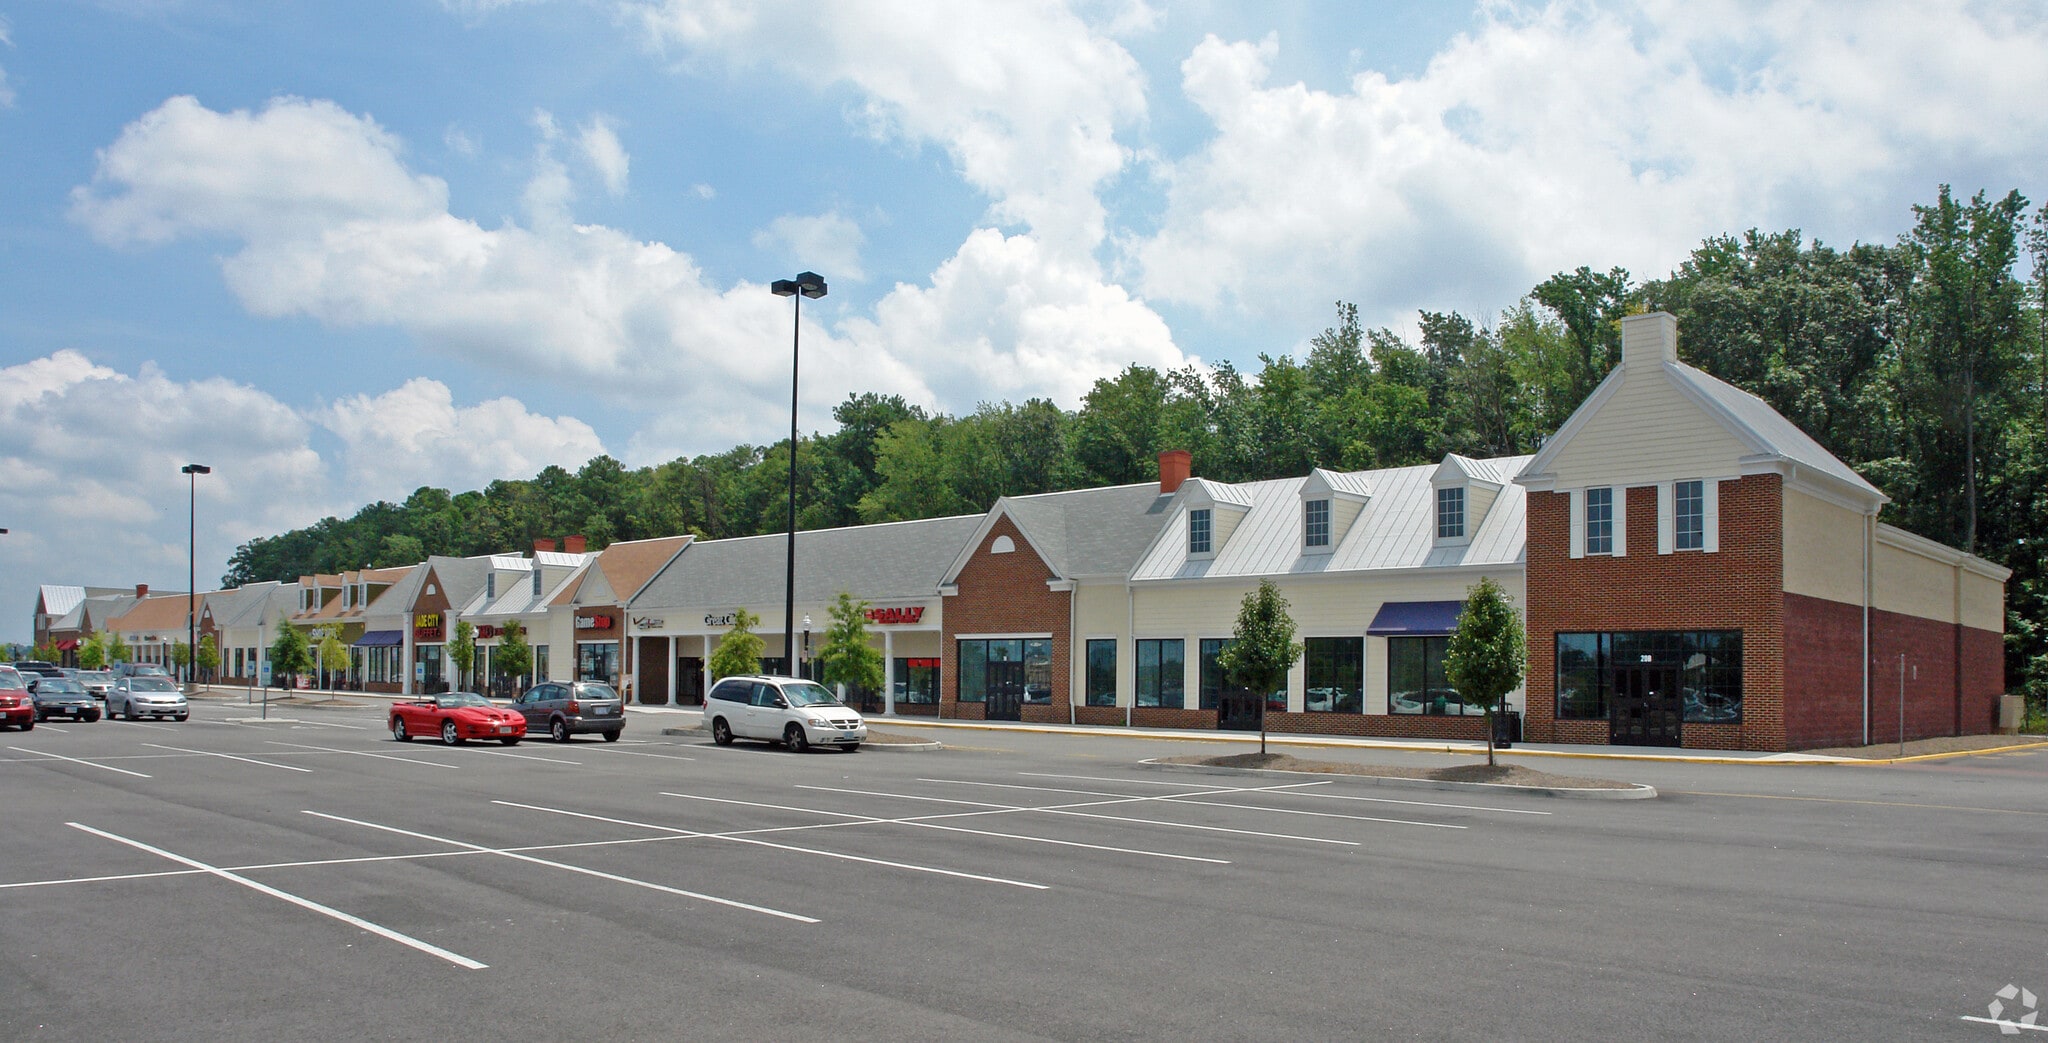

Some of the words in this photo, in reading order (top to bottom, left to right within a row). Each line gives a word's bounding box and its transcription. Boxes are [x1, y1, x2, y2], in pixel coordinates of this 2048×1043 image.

[428, 613, 439, 627] CITY
[874, 607, 925, 620] SALLY
[575, 615, 612, 630] GameStop
